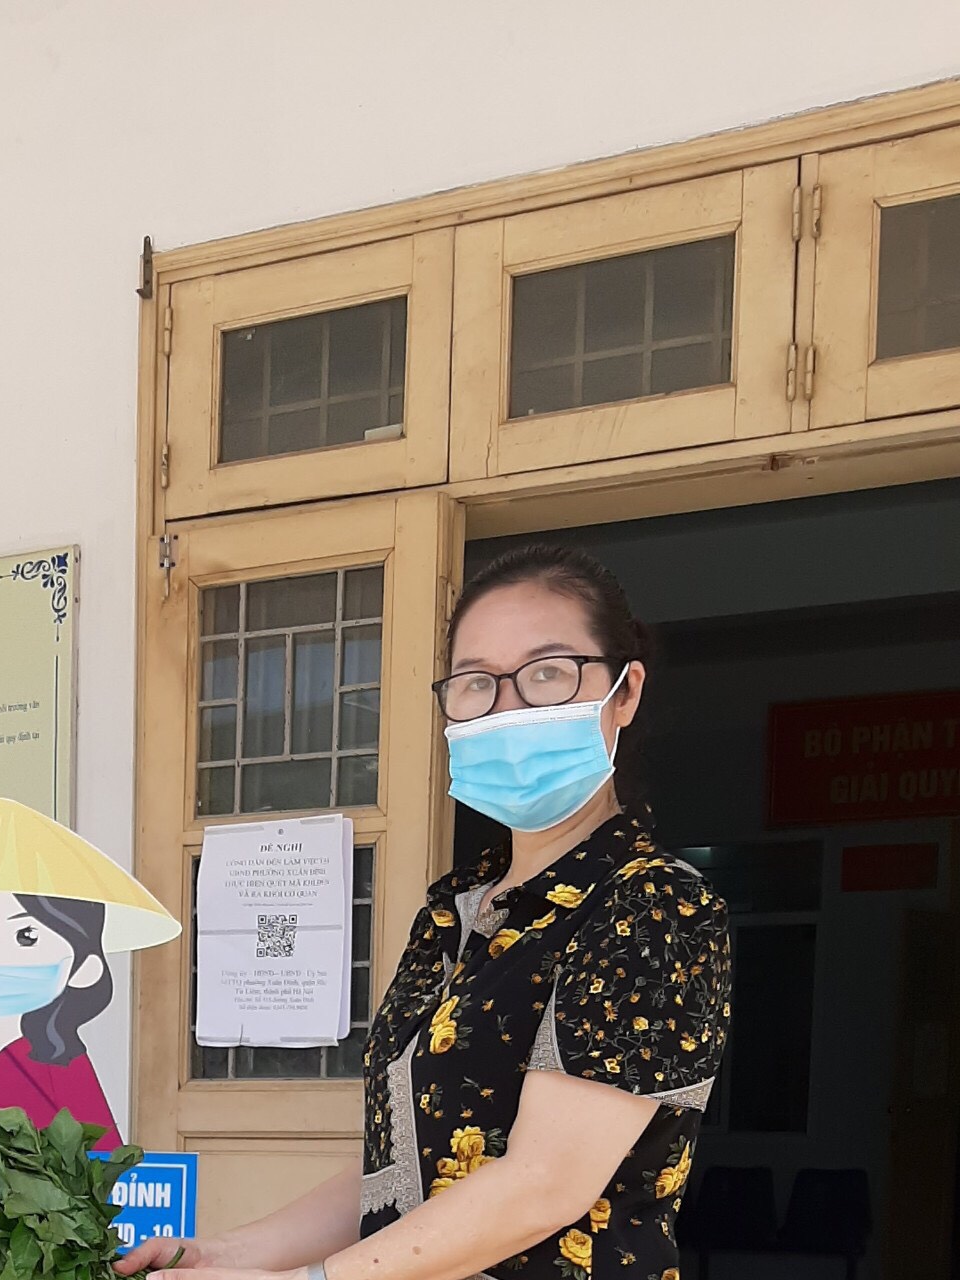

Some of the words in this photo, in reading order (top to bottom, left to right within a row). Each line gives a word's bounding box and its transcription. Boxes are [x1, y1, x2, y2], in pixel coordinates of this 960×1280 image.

[804, 724, 842, 763] BỘ
[851, 717, 933, 759] PHẬN
[830, 762, 888, 804] GIẢI
[897, 768, 960, 803] QUY
[112, 1172, 171, 1208] ĐỈNH
